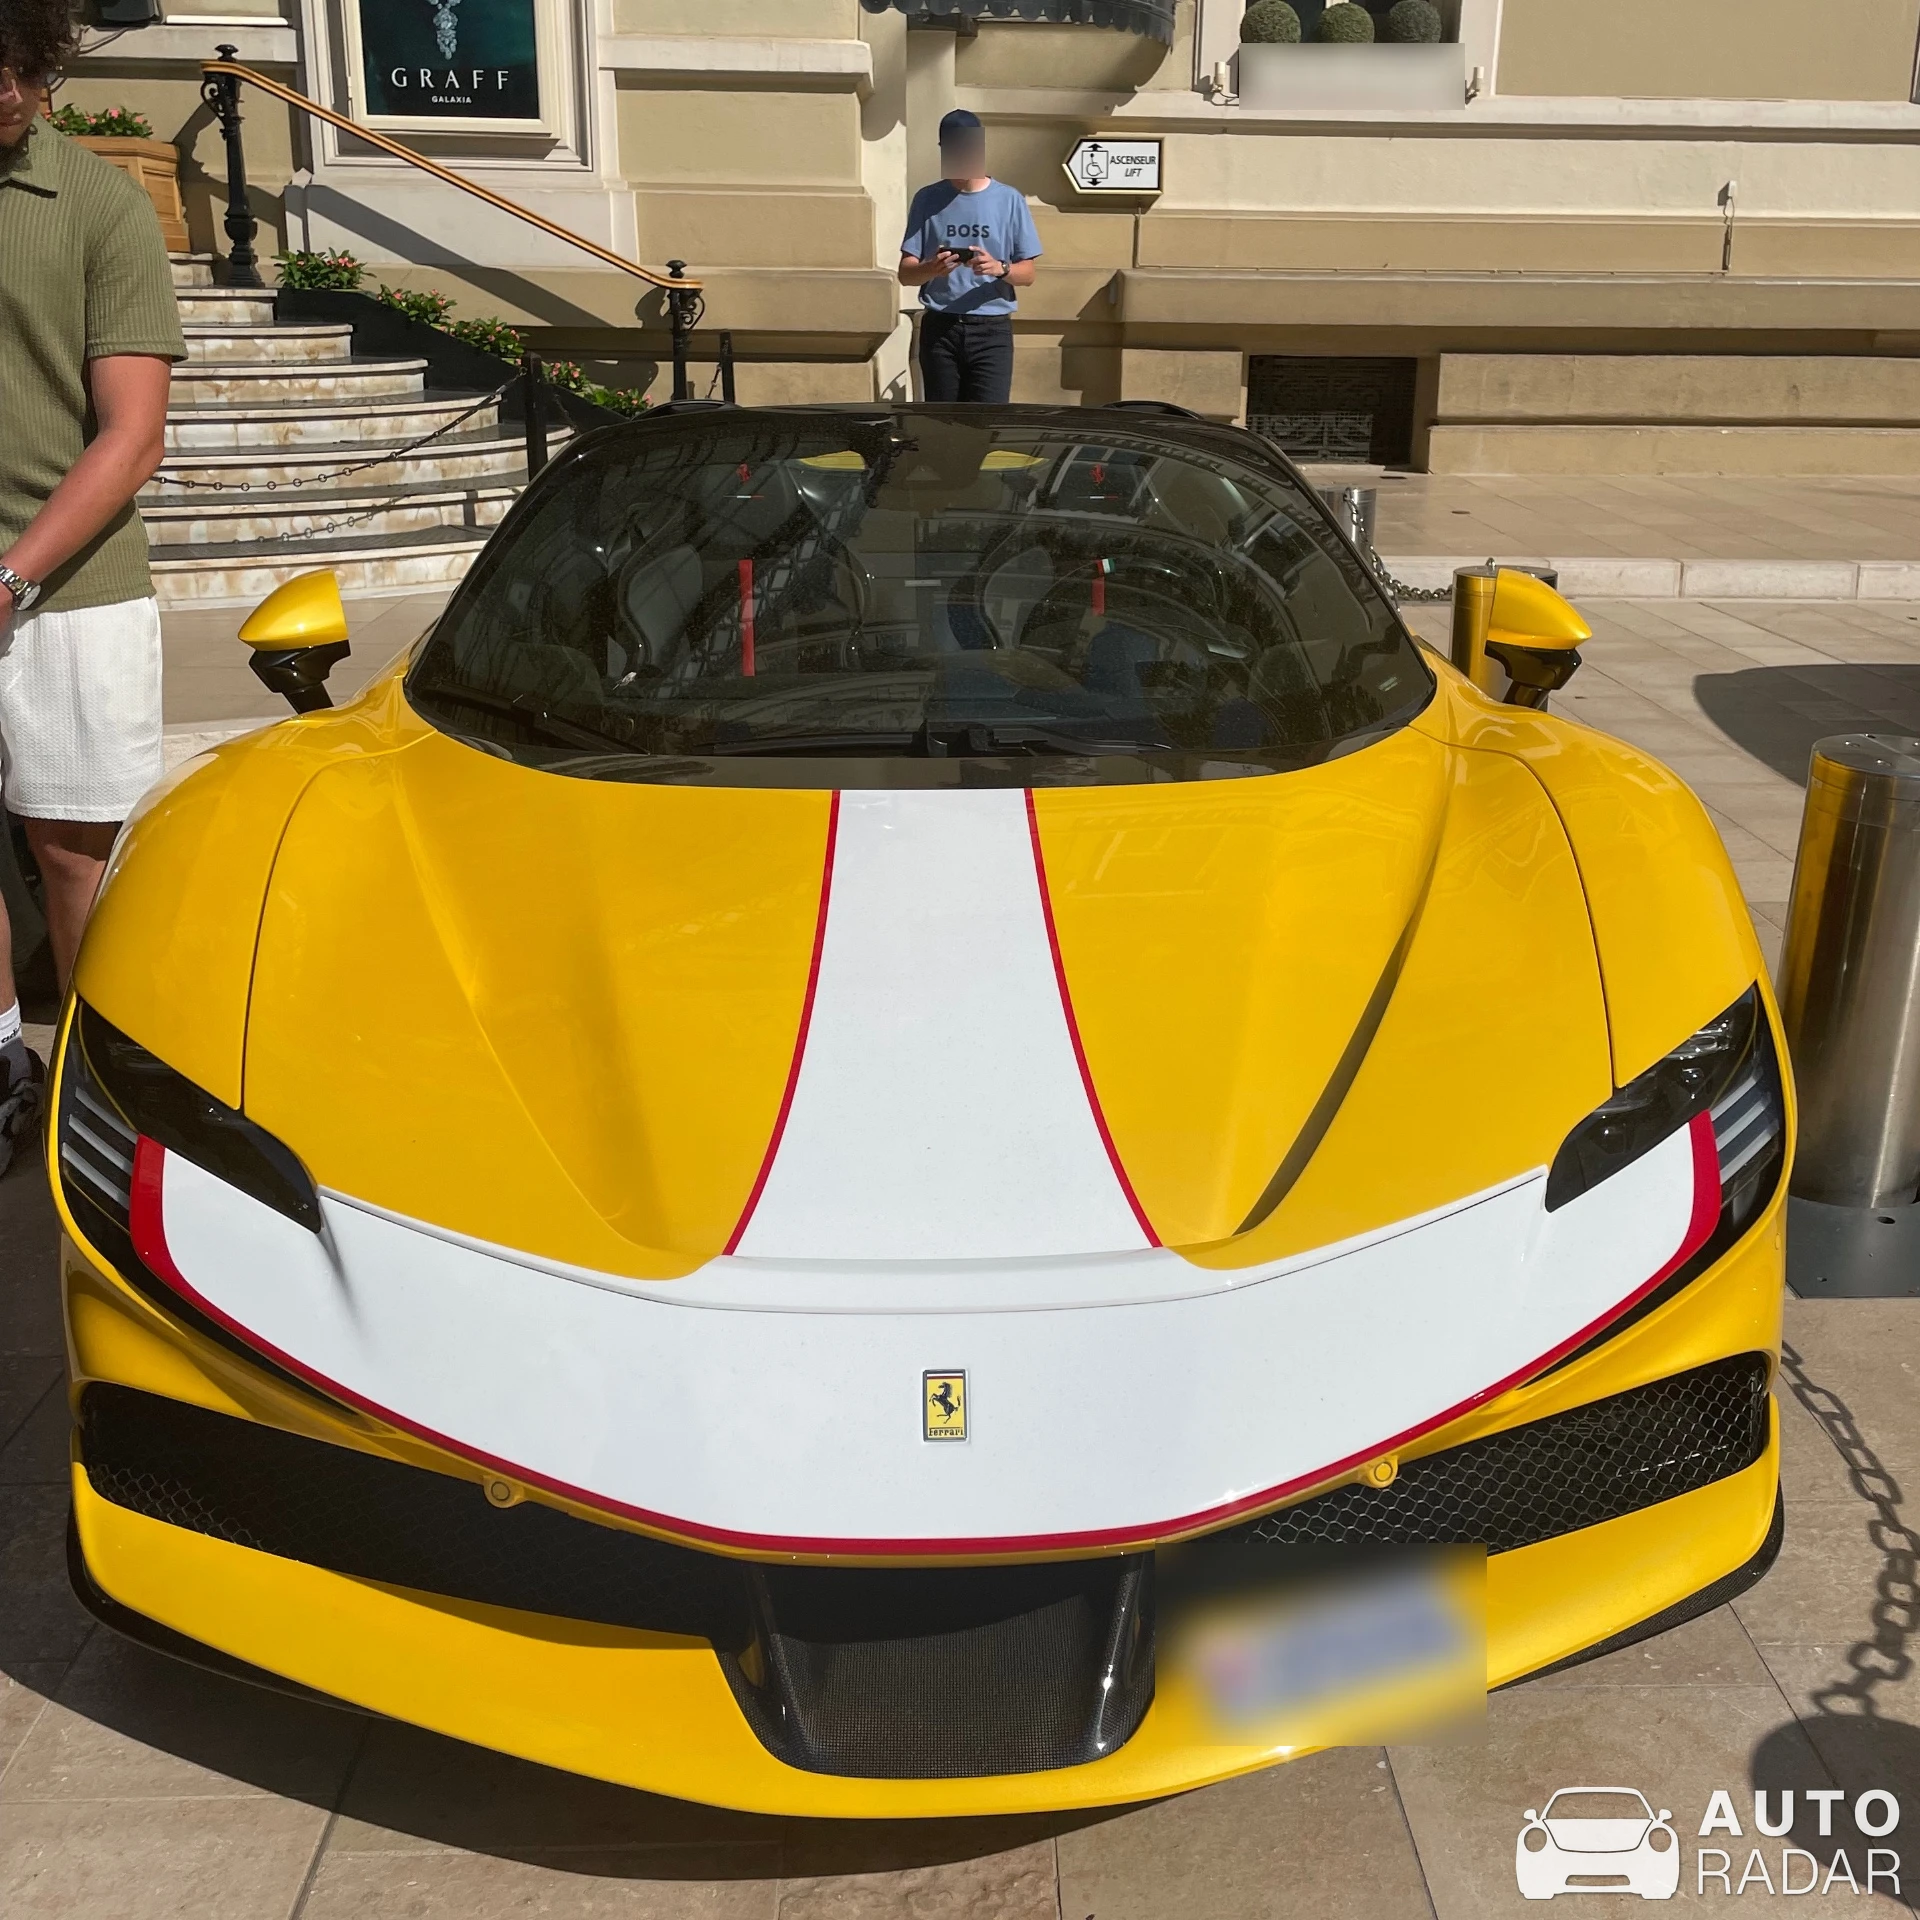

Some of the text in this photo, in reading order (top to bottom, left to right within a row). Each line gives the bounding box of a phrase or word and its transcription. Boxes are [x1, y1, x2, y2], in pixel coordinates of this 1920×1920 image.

[391, 67, 509, 90] GRAFF
[431, 95, 472, 104] GALAXIA
[1109, 155, 1157, 165] ASCENSEUR
[1124, 168, 1143, 178] LIFT
[946, 224, 990, 238] BOSS
[928, 1427, 964, 1437] Ferrari
